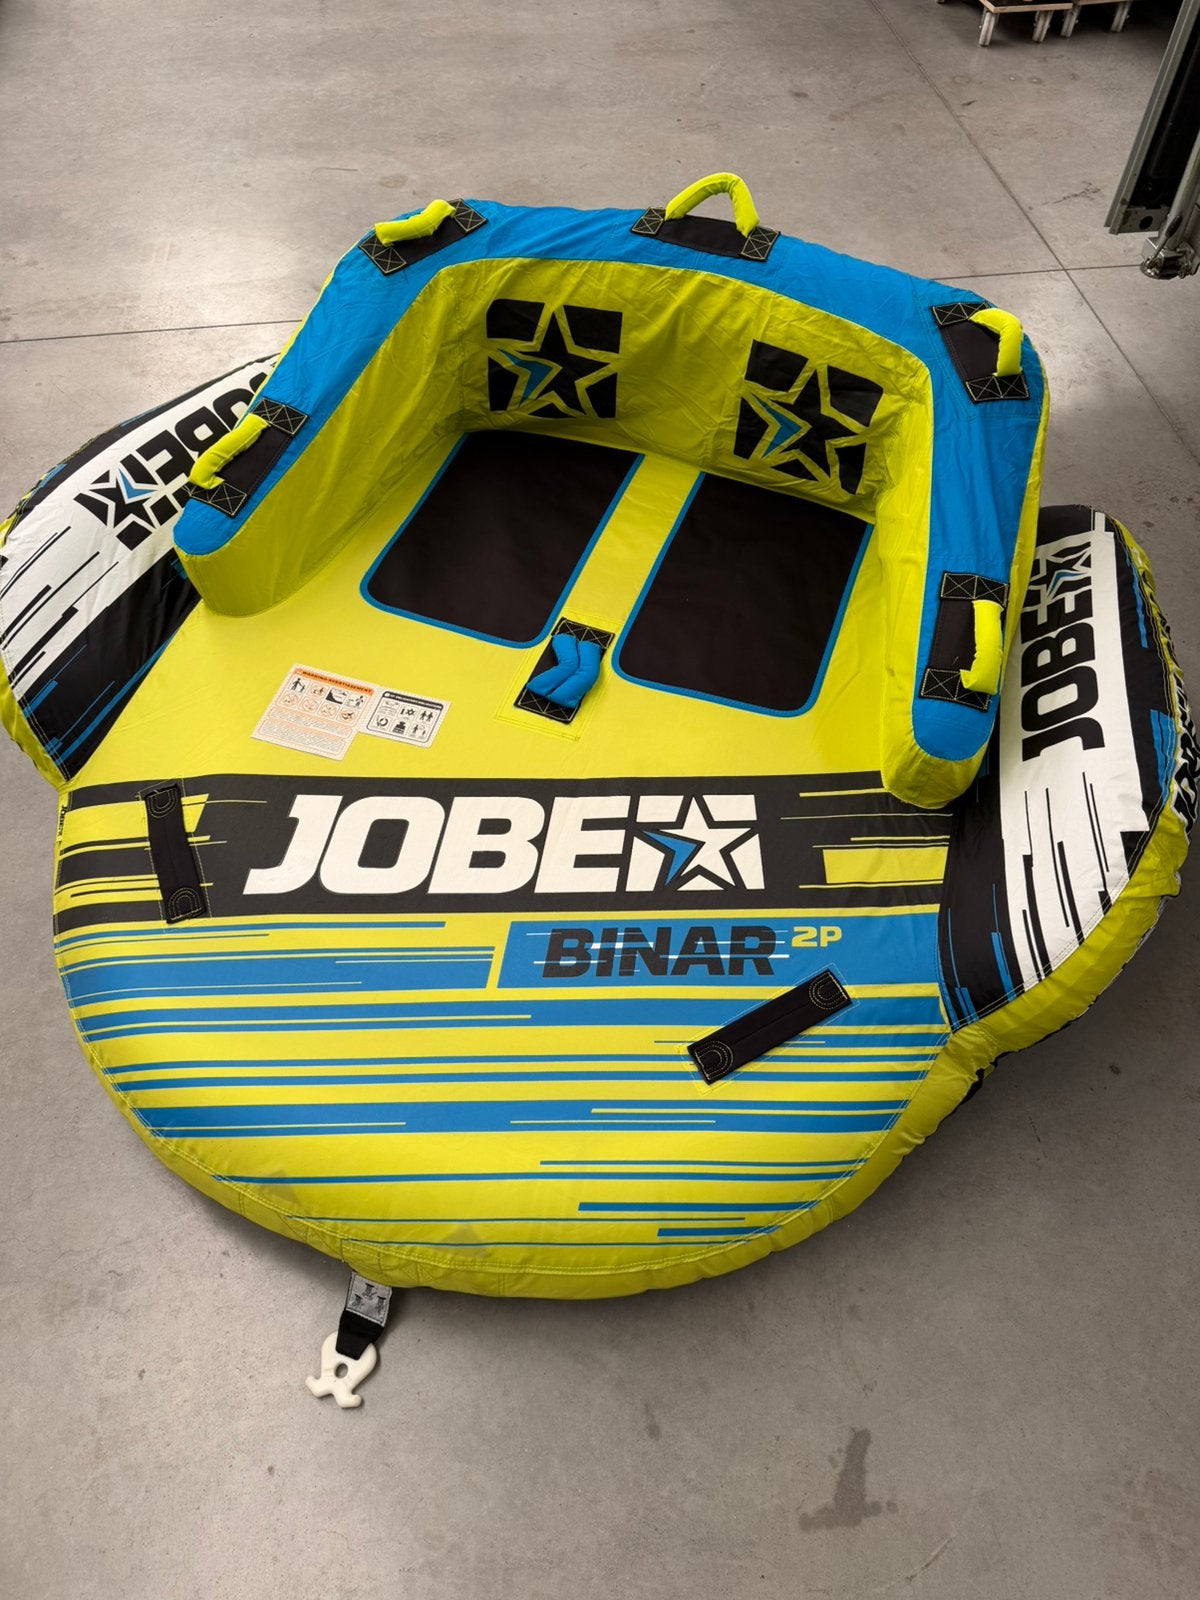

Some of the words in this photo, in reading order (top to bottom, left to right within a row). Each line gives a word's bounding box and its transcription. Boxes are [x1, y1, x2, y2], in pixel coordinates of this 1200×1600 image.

[136, 372, 268, 508] OBE
[1021, 588, 1105, 762] JOBE
[242, 794, 631, 895] JOBE
[542, 926, 777, 979] BINAR
[791, 926, 843, 948] 2P
